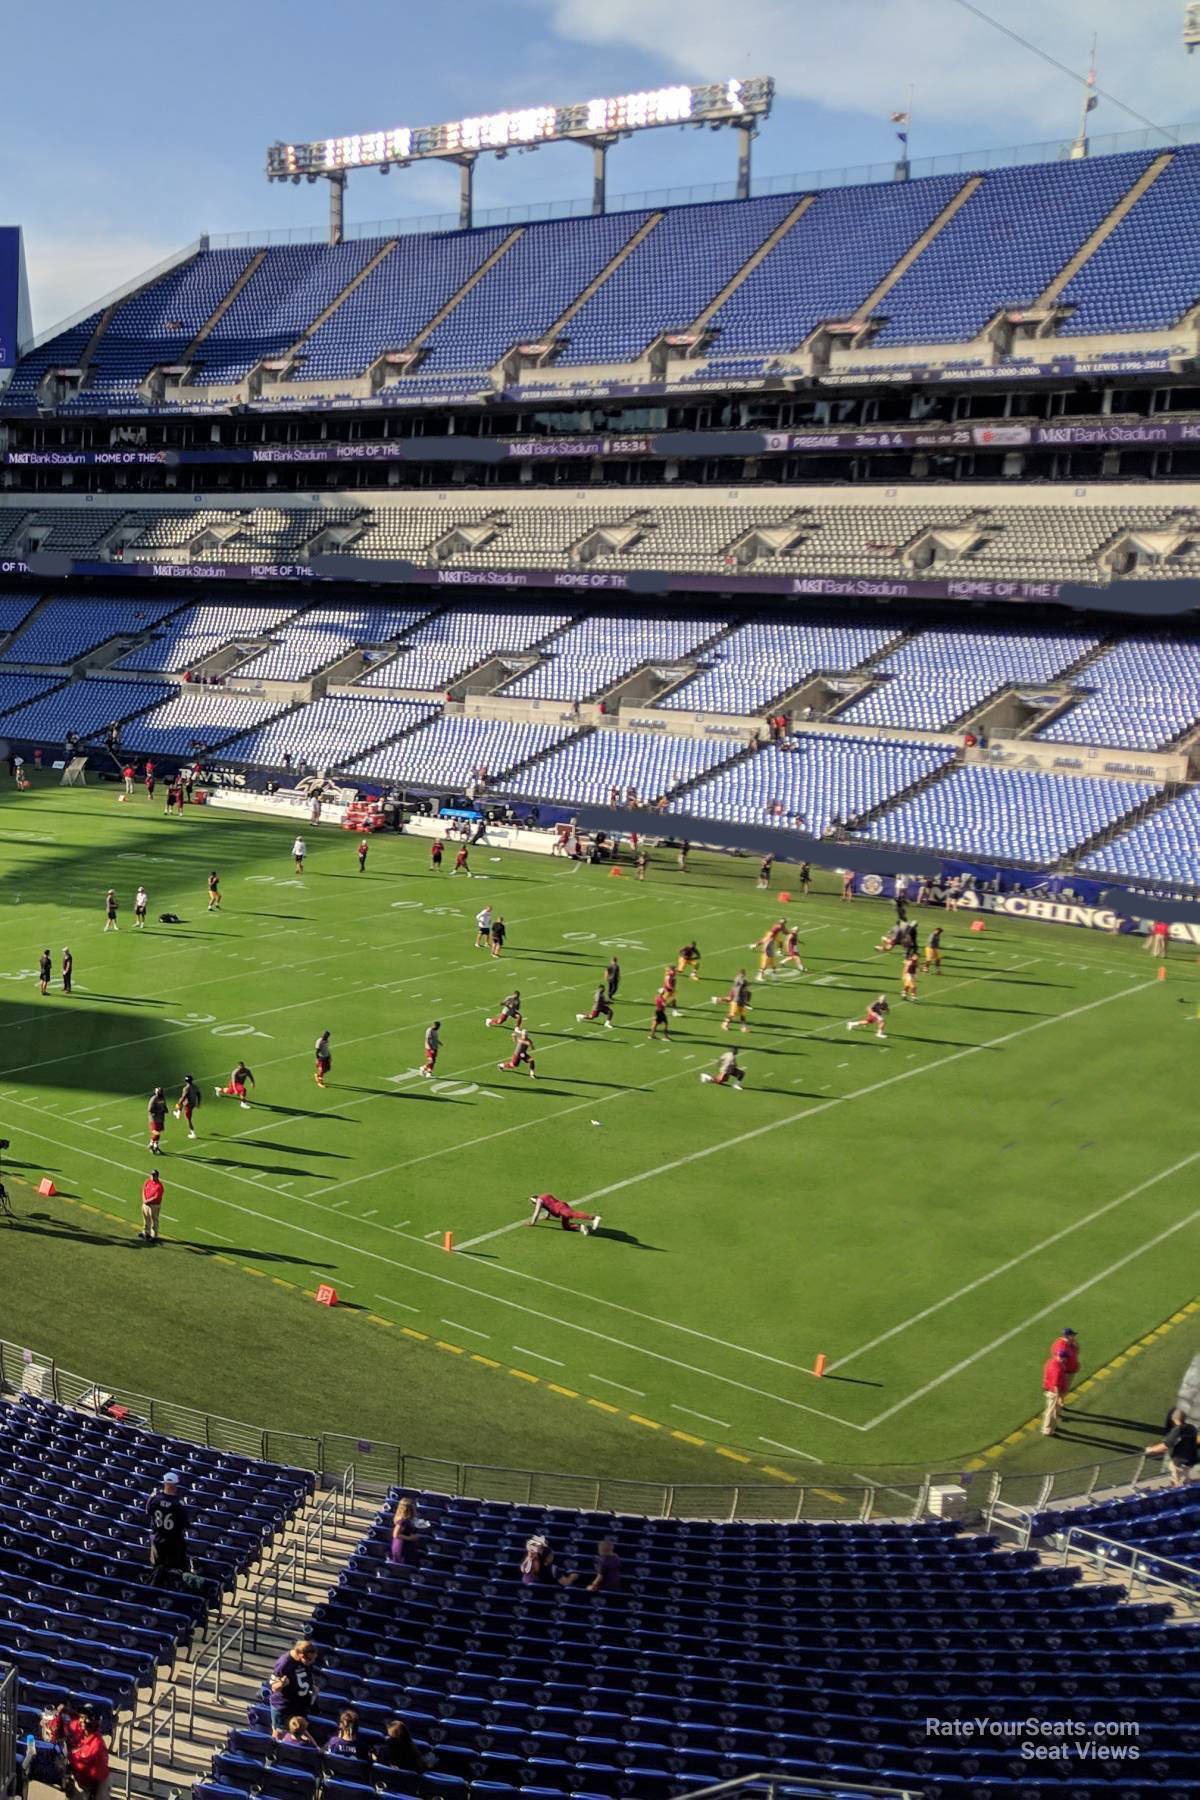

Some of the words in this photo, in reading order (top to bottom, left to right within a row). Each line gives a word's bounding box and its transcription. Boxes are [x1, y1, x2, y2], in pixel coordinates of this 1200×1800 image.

[952, 432, 970, 443] 25
[1075, 427, 1107, 441] Bank
[1108, 425, 1167, 441] Stadium
[793, 436, 839, 447] PREGAME
[879, 435, 890, 445] &
[892, 434, 903, 444] 4
[337, 446, 365, 456] HOME
[366, 445, 380, 456] OF
[382, 444, 400, 455] THE
[558, 441, 598, 455] Stadium
[51, 453, 85, 463] Stadium
[95, 453, 121, 463] HOME
[123, 453, 135, 462] OF
[138, 453, 155, 462] THE
[294, 450, 327, 460] Stadium
[2, 562, 15, 571] OF
[18, 563, 33, 572] TH
[193, 566, 226, 577] Stadium
[251, 566, 278, 576] HOME
[279, 566, 293, 576] OF
[295, 566, 313, 576] THE
[487, 572, 527, 585] Stadium
[555, 574, 588, 585] HOME
[591, 575, 608, 586] OF
[610, 575, 628, 587] TH
[856, 581, 907, 596] Stadium
[948, 582, 992, 596] HOME
[994, 584, 1017, 596] OF
[1022, 584, 1049, 597] THE
[179, 768, 246, 785] RAVENS
[164, 1012, 256, 1037] 20
[380, 1067, 480, 1097] 10
[154, 1510, 174, 1530] 86
